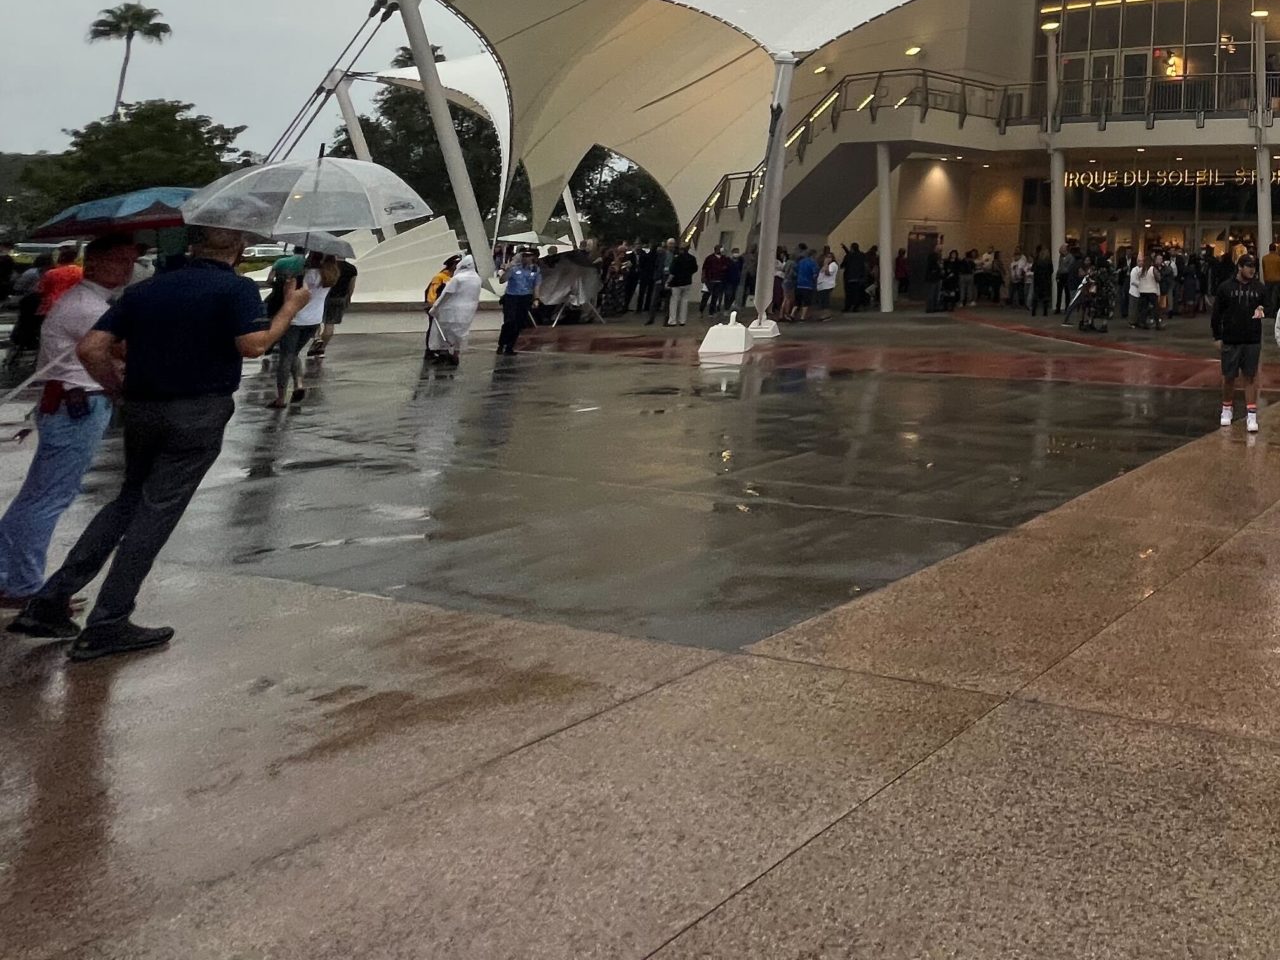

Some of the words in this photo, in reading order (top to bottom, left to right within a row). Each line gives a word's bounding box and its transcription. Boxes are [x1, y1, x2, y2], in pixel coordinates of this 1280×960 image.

[1064, 170, 1118, 193] IRQUE
[1124, 169, 1150, 186] DU
[1156, 168, 1224, 187] SOLEIL
